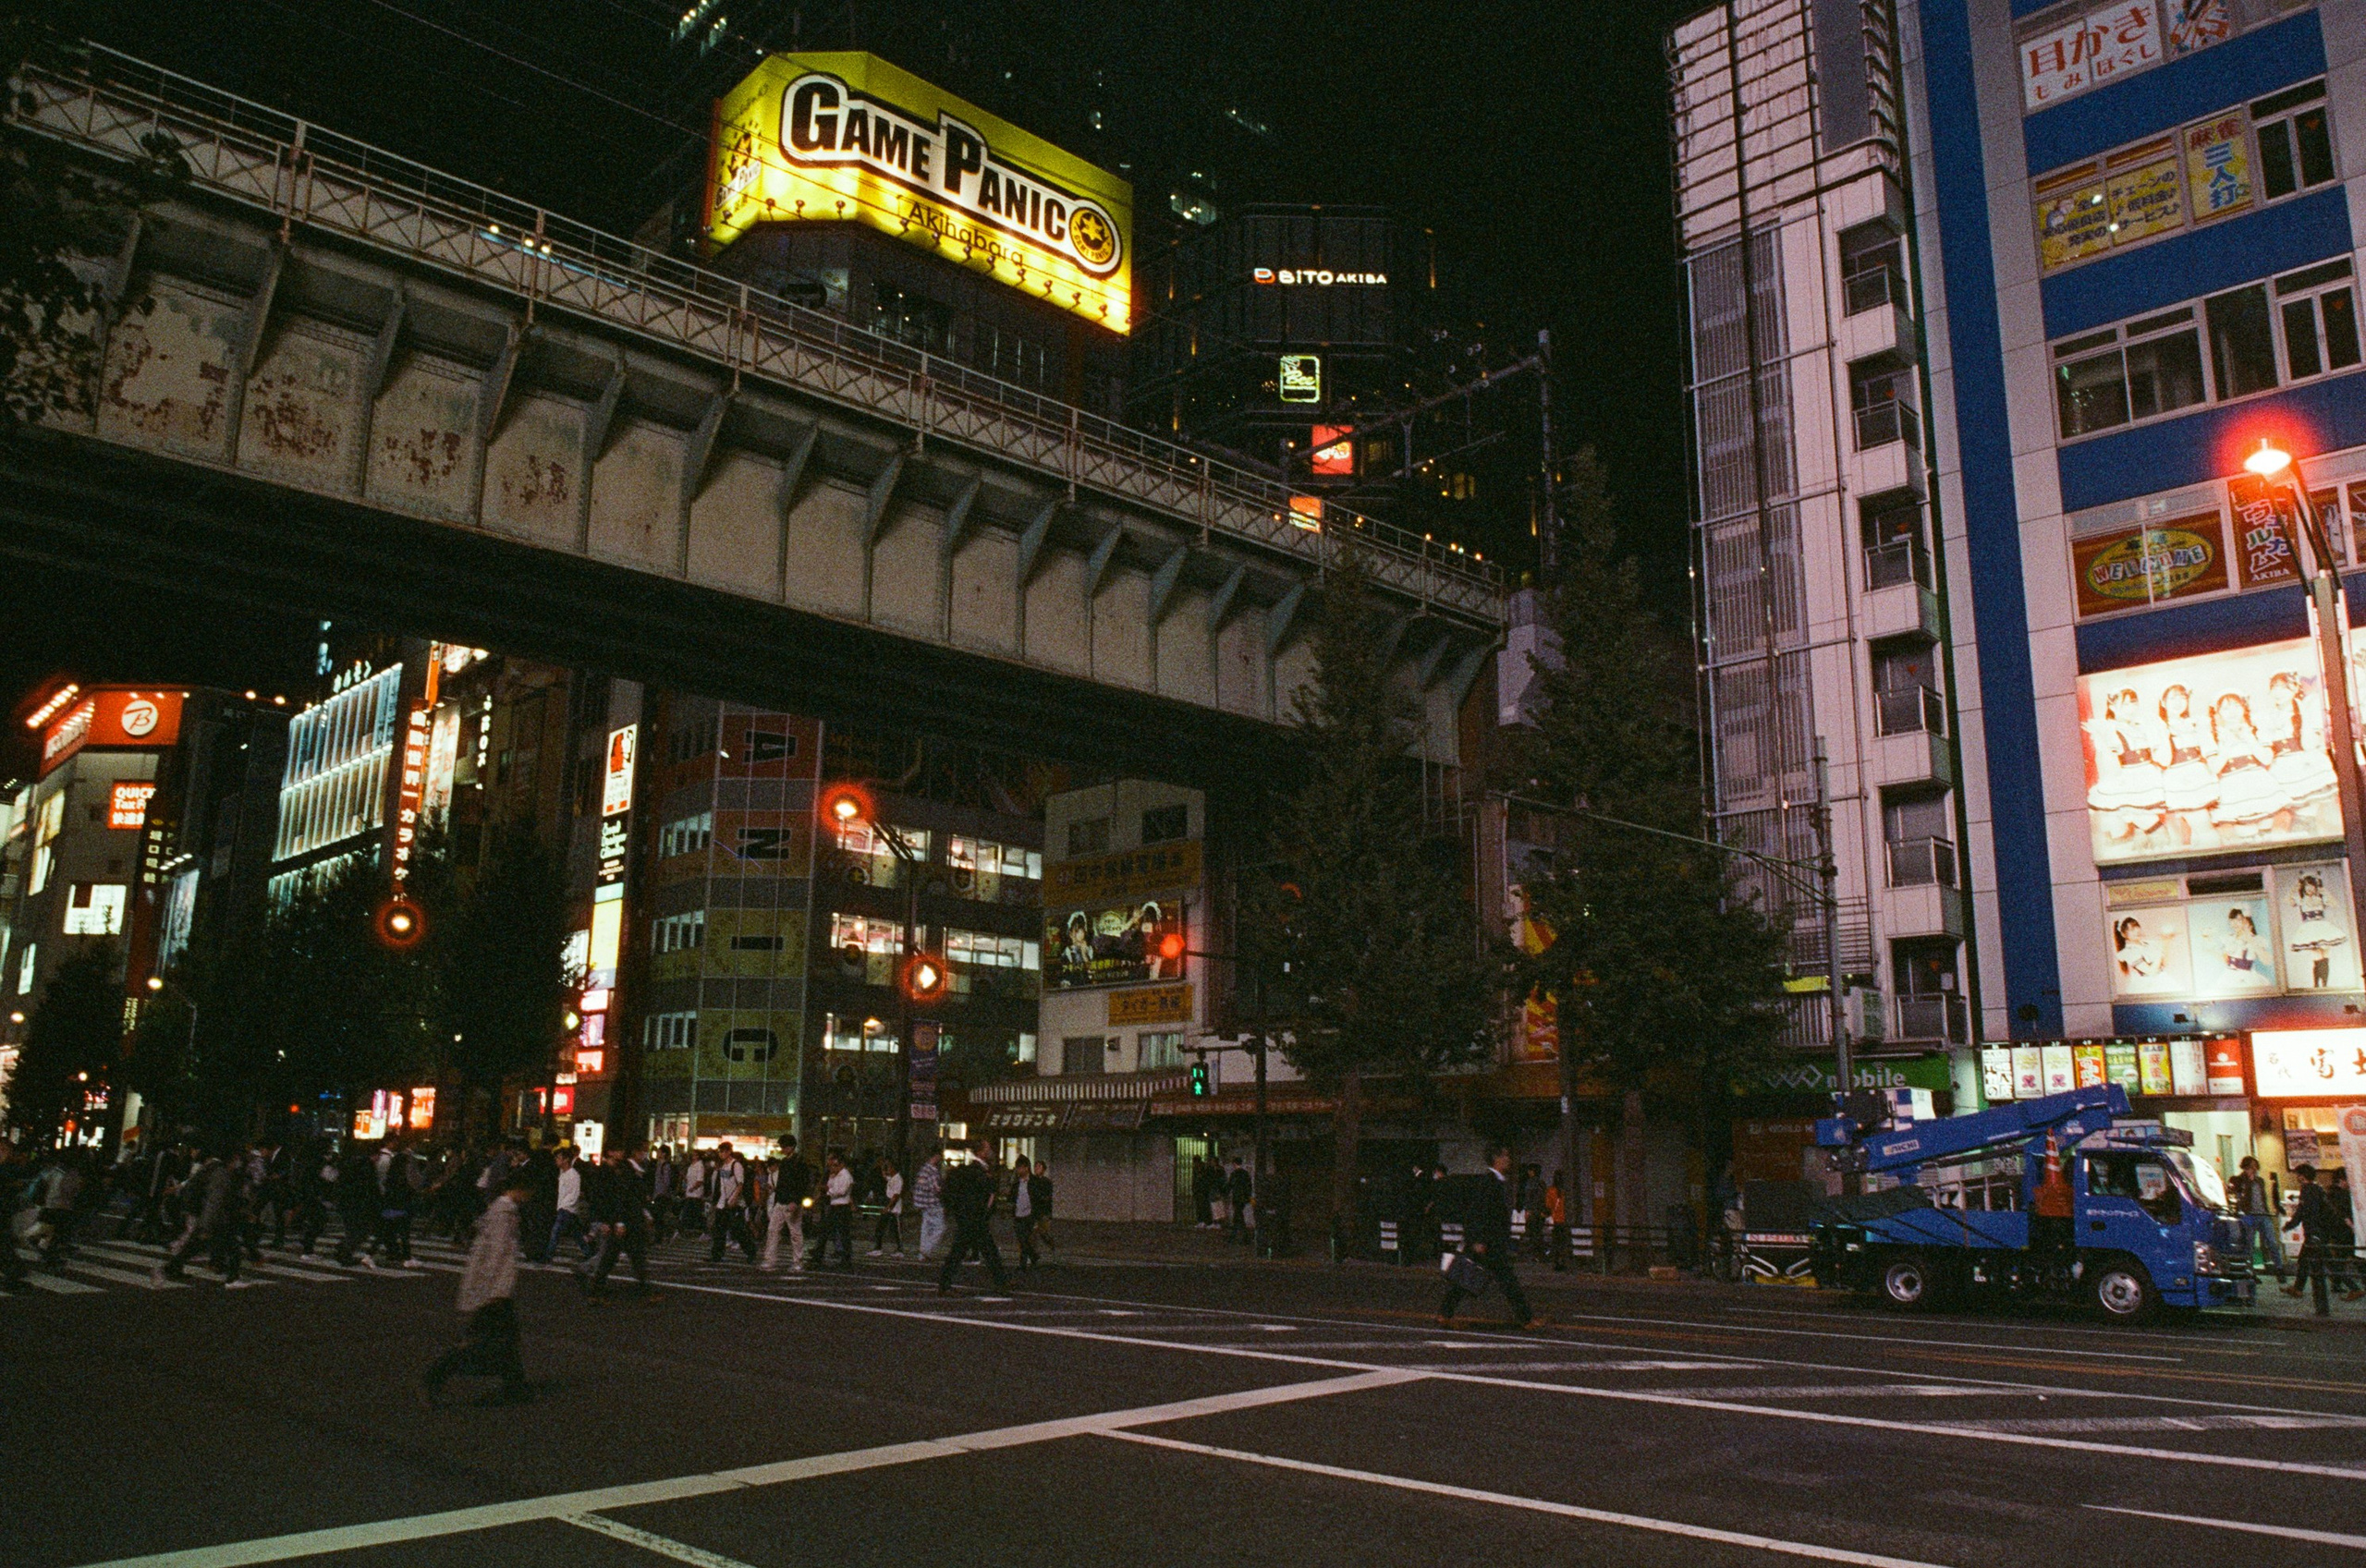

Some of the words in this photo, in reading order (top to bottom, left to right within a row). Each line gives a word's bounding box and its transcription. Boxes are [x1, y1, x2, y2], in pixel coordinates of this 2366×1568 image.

[2034, 43, 2159, 100] もみほぐし
[791, 81, 933, 182] GAME
[944, 127, 1067, 241] PANIC
[2204, 142, 2238, 210] 三人打
[909, 200, 1025, 265] Akihabara
[2092, 544, 2206, 585] WELCOME
[1826, 1066, 1907, 1089] mbile
